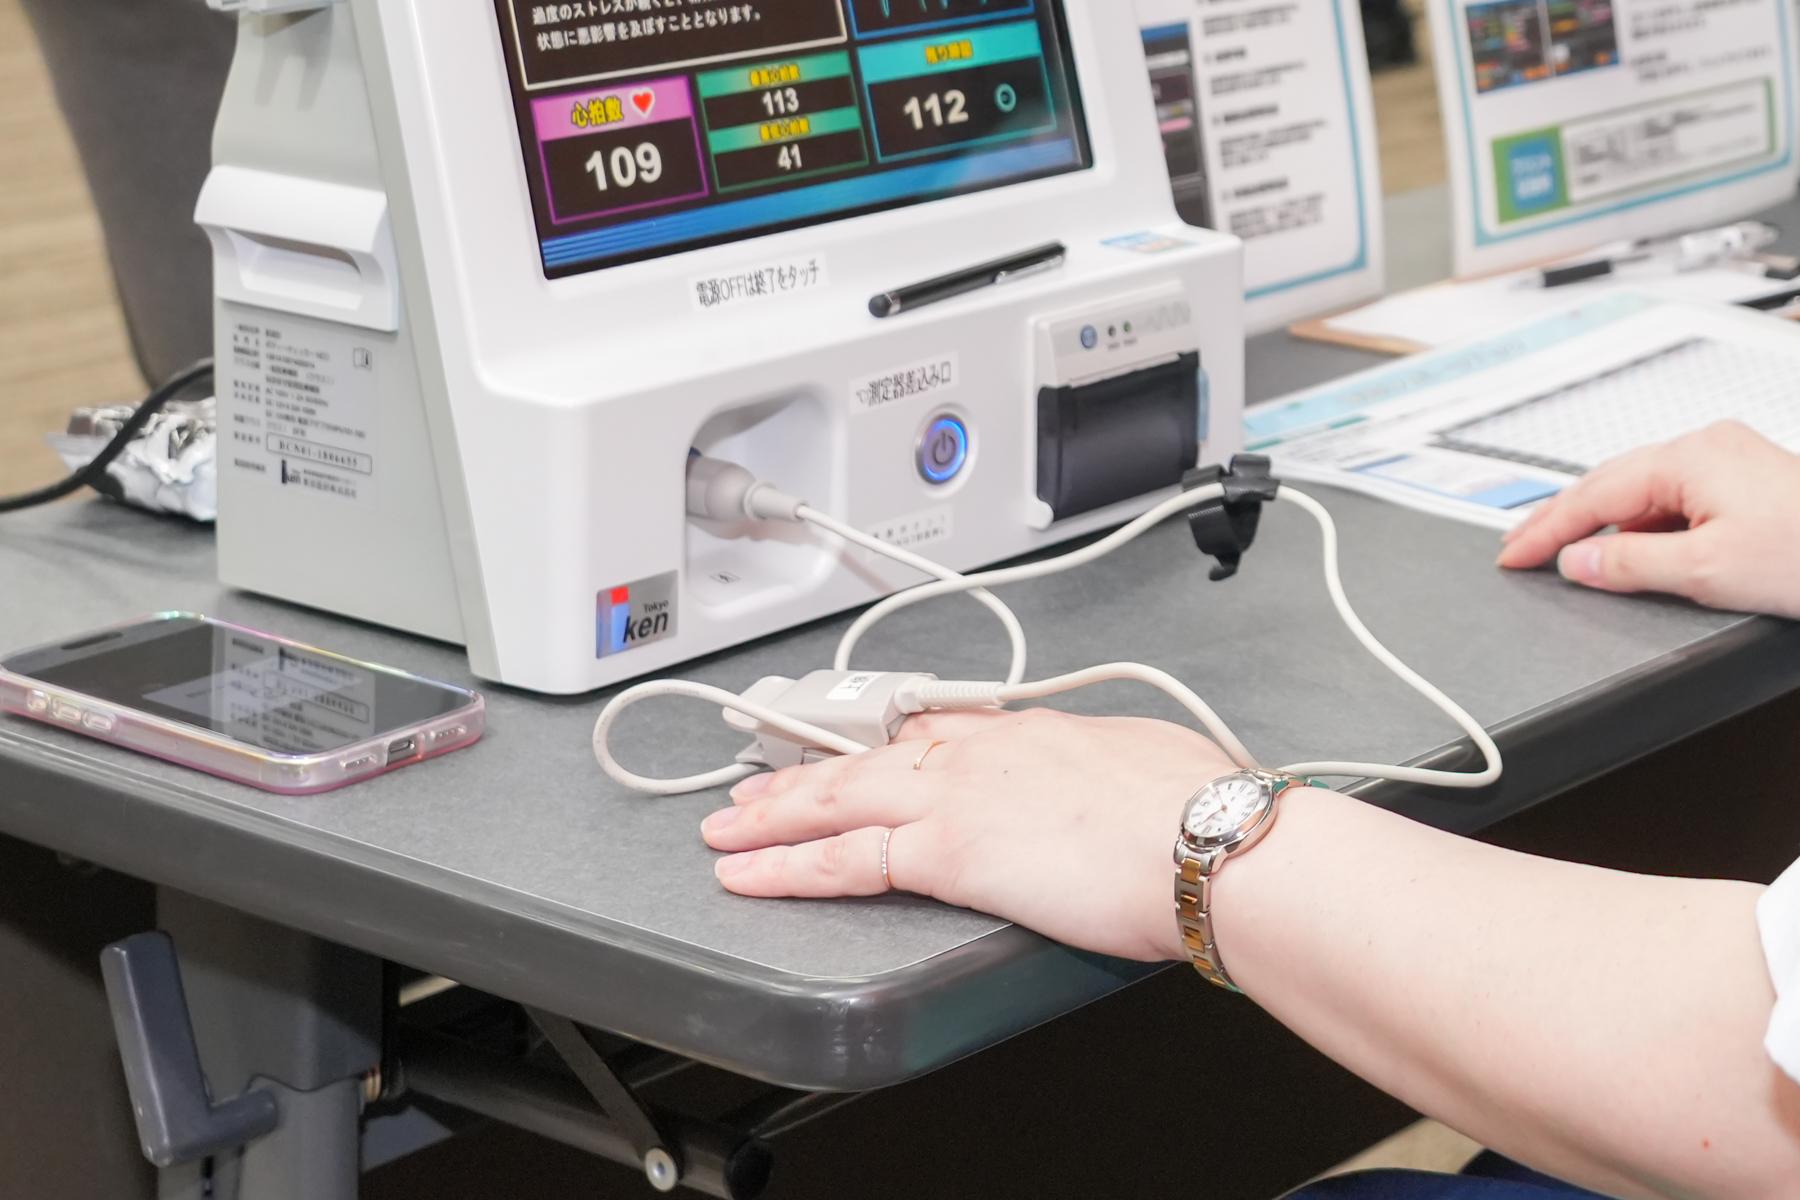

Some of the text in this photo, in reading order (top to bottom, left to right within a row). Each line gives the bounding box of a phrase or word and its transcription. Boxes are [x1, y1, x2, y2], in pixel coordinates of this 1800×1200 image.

[571, 96, 624, 128] 心拍数
[762, 87, 799, 116] 113
[904, 89, 969, 131] 112
[585, 142, 662, 192] 109
[777, 144, 803, 171] 41
[696, 258, 819, 307] 電源OFFは終了をタッチ
[644, 600, 669, 613] Tokyo
[623, 612, 668, 643] ken
